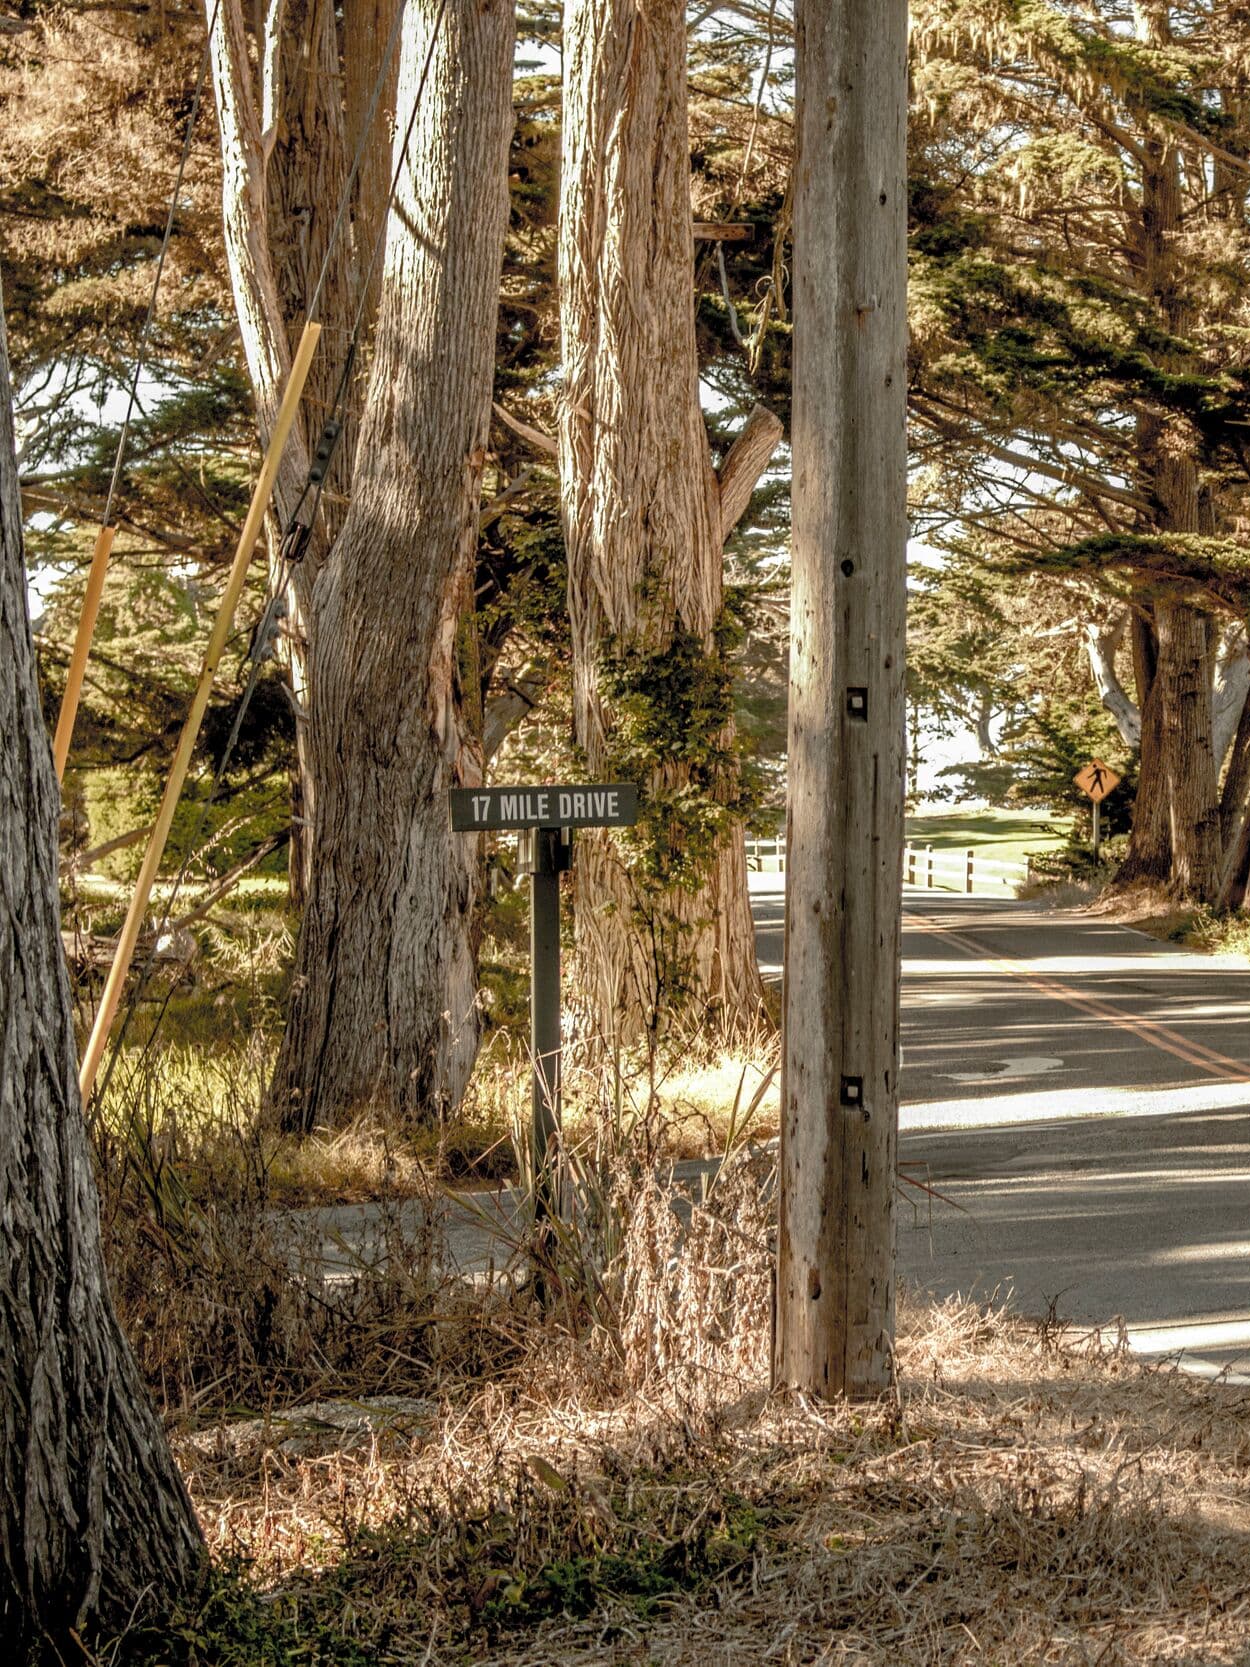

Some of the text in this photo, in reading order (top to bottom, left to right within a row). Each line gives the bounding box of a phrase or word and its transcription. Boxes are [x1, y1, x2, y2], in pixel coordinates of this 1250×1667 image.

[472, 792, 619, 821] 17 MILE DRIVE
